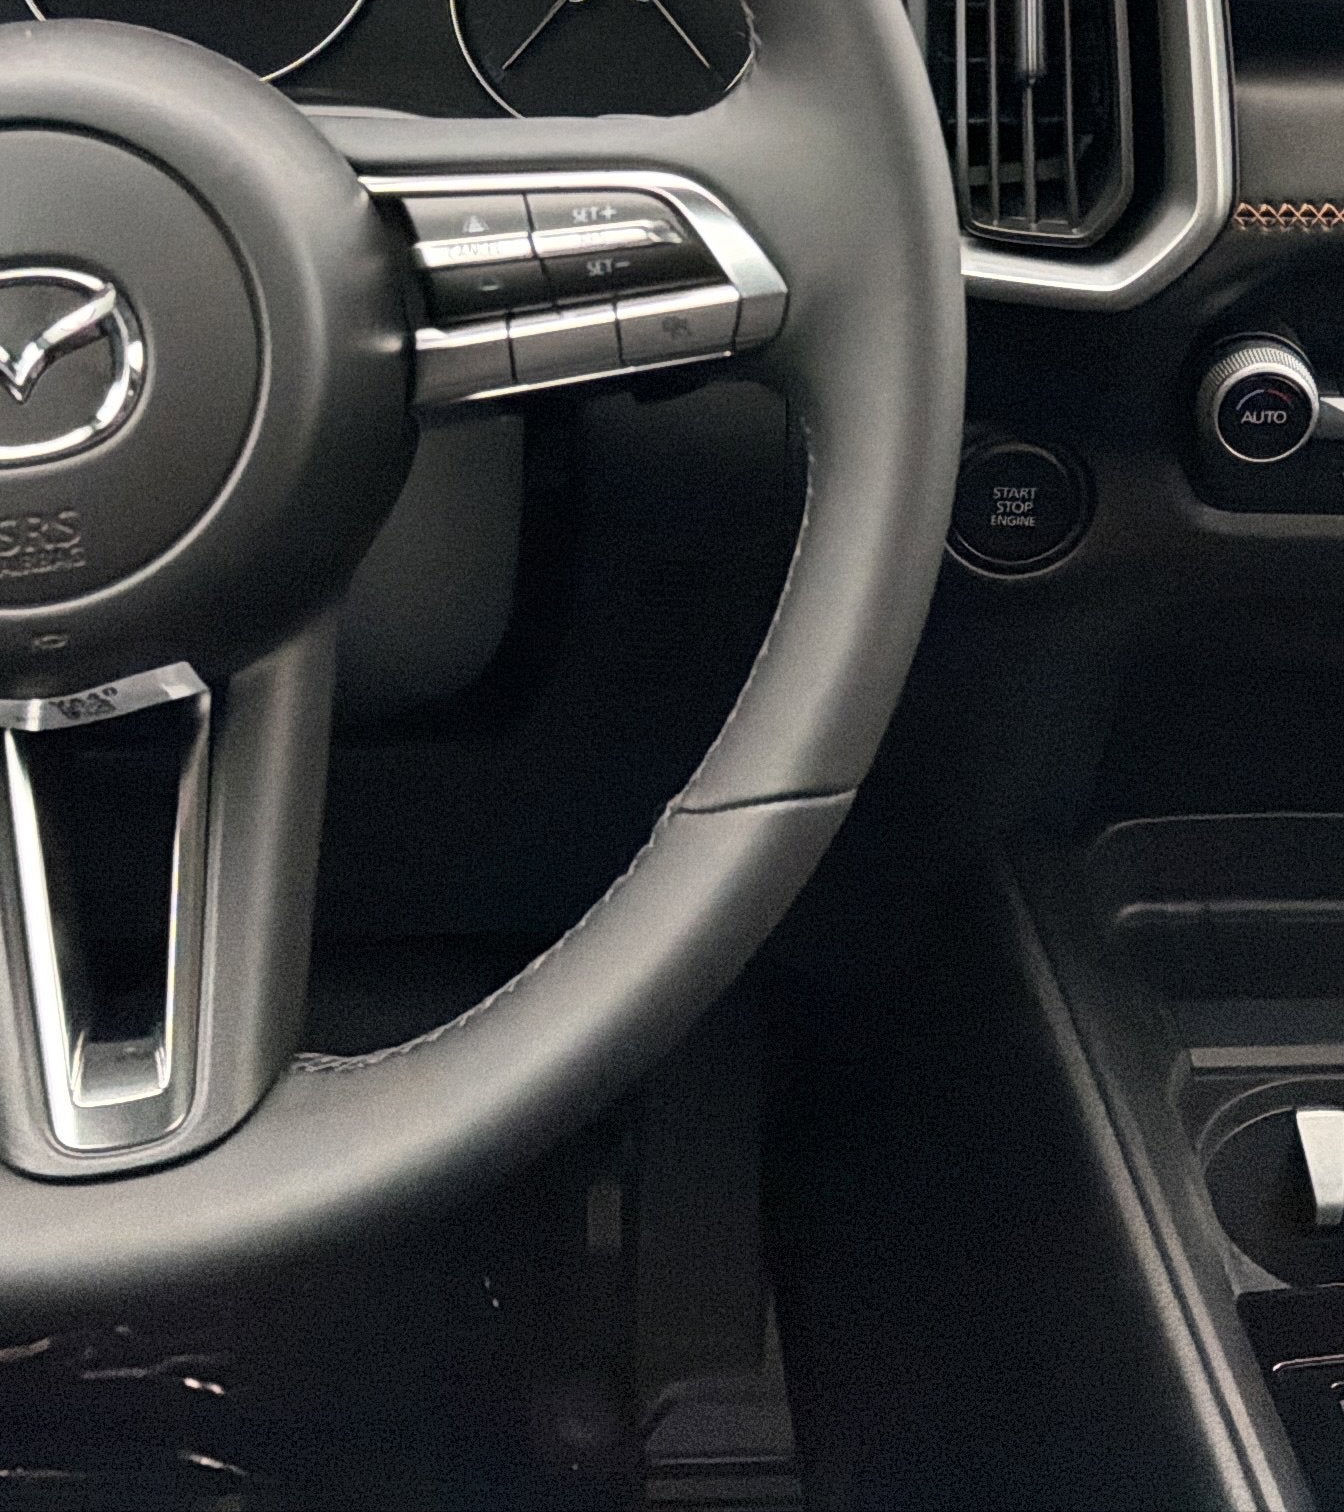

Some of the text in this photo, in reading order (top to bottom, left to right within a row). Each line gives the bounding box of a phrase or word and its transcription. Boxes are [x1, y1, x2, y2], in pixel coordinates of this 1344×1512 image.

[1240, 410, 1287, 424] AUTO
[992, 487, 1037, 500] START
[996, 500, 1034, 514] STOP
[990, 515, 1037, 527] ENGINE
